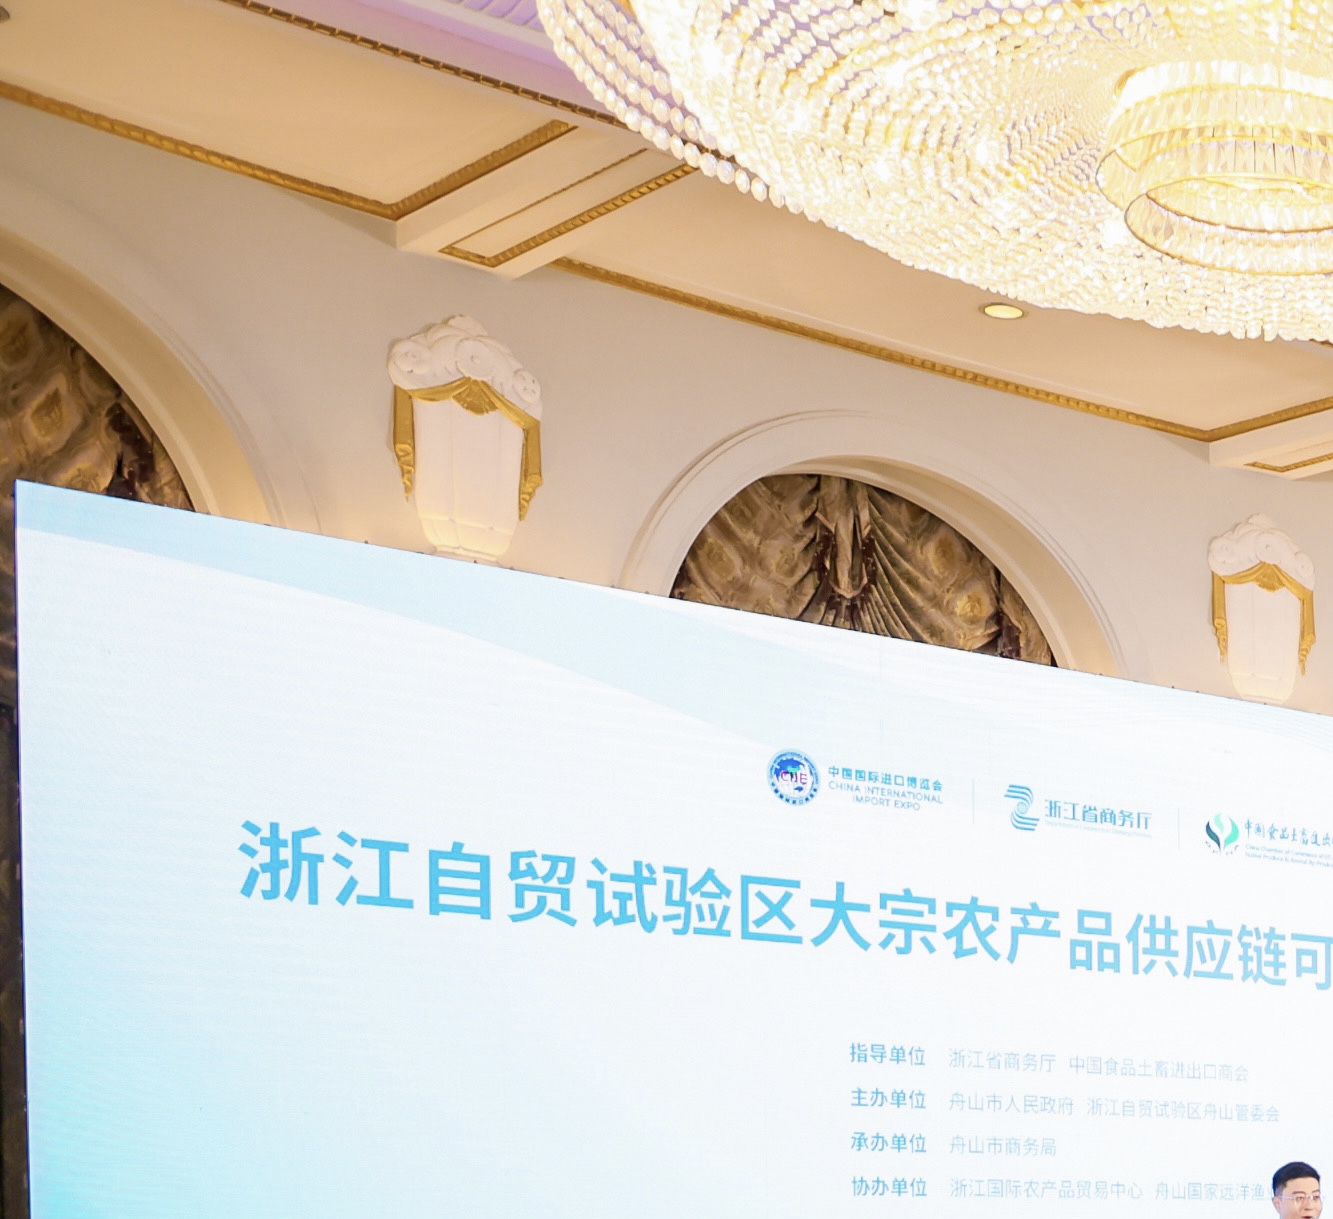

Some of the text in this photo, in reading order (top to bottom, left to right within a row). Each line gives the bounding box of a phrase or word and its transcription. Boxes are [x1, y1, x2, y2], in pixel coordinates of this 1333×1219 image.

[828, 765, 943, 792] 中国国际进口博览会
[828, 780, 943, 804] CHINA INTERNATIONAL
[852, 794, 921, 811] IMPORT EXPO
[1044, 799, 1153, 830] 浙江省商务厅
[850, 1042, 1250, 1083] 指导单位 浙江省商务厅 中国食品土畜进出口商会
[850, 1087, 1281, 1124] 主办单位 舟山市人民政府 浙江自贸试验区舟山管委会
[850, 1132, 1057, 1158] 承办单位 舟山市商务局
[851, 1176, 928, 1199] 协办单位
[949, 1177, 1144, 1202] 浙江国际农产品贸易中心
